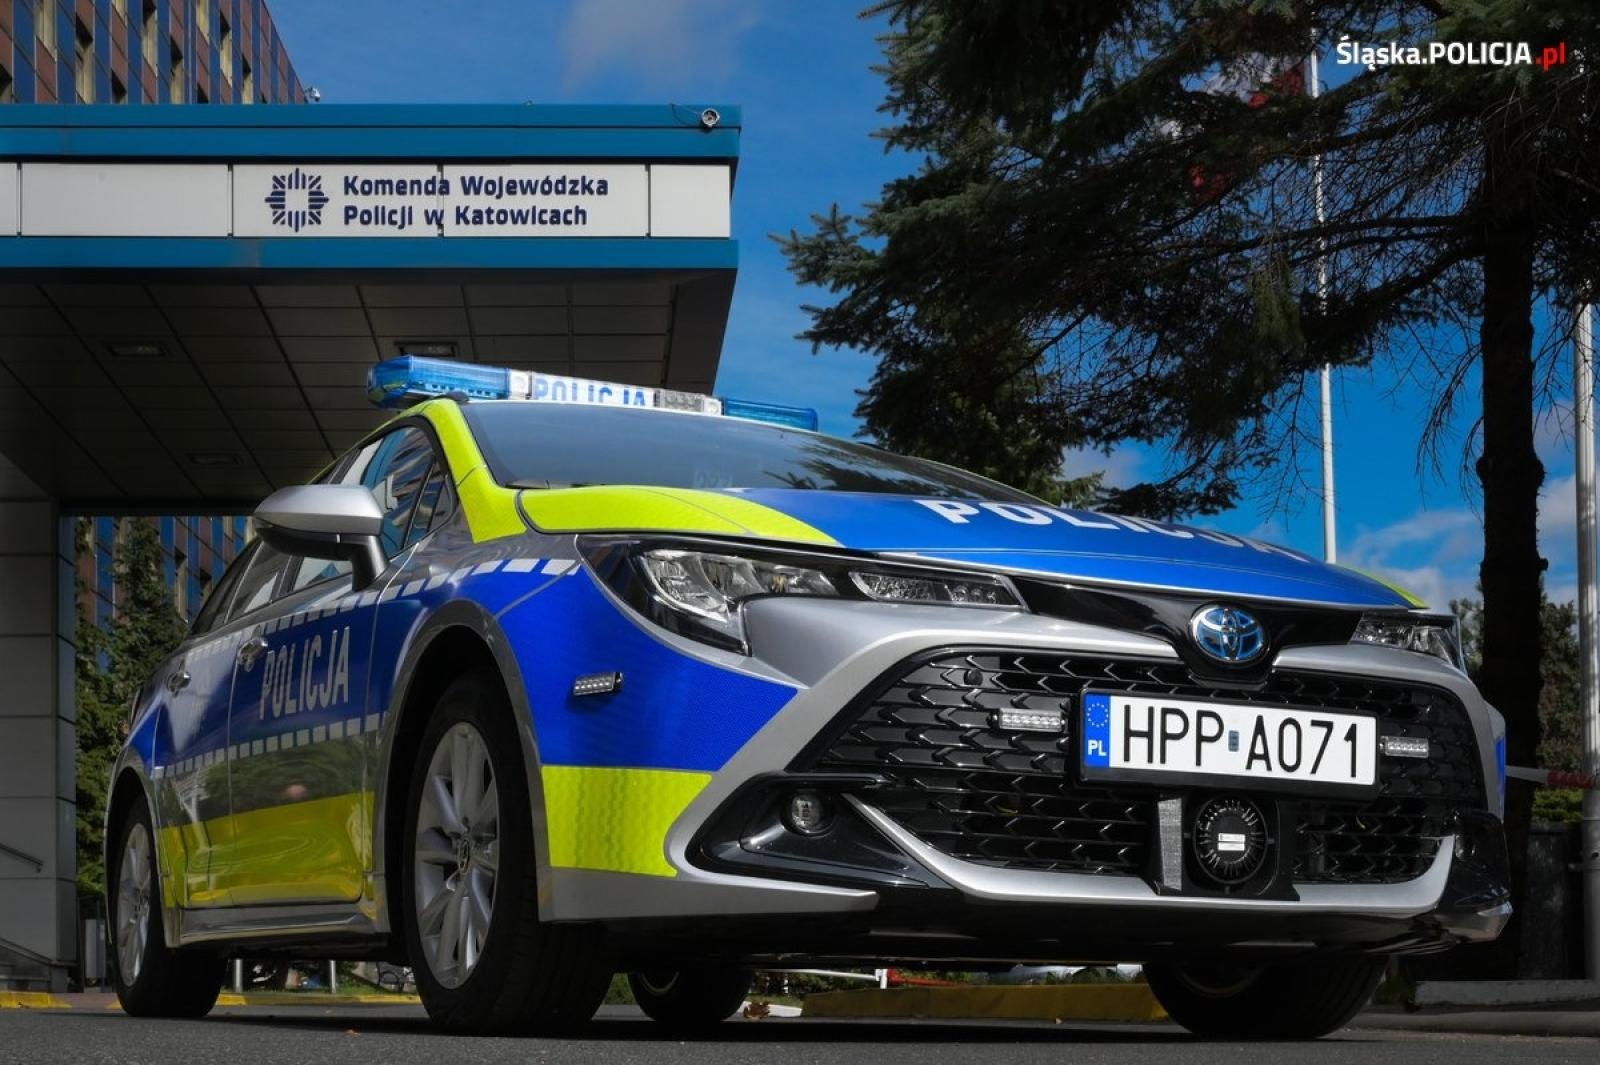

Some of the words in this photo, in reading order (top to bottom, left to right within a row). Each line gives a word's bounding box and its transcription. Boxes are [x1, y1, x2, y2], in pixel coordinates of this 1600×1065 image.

[343, 175, 450, 196] Komenda
[460, 175, 609, 199] Wojewódzka
[343, 205, 413, 228] Policji
[424, 209, 444, 226] w
[455, 205, 588, 226] Katowicach
[259, 626, 351, 720] POLICJA
[1087, 739, 1107, 757] PL
[1123, 704, 1225, 767] HPP
[1245, 714, 1357, 778] A071
